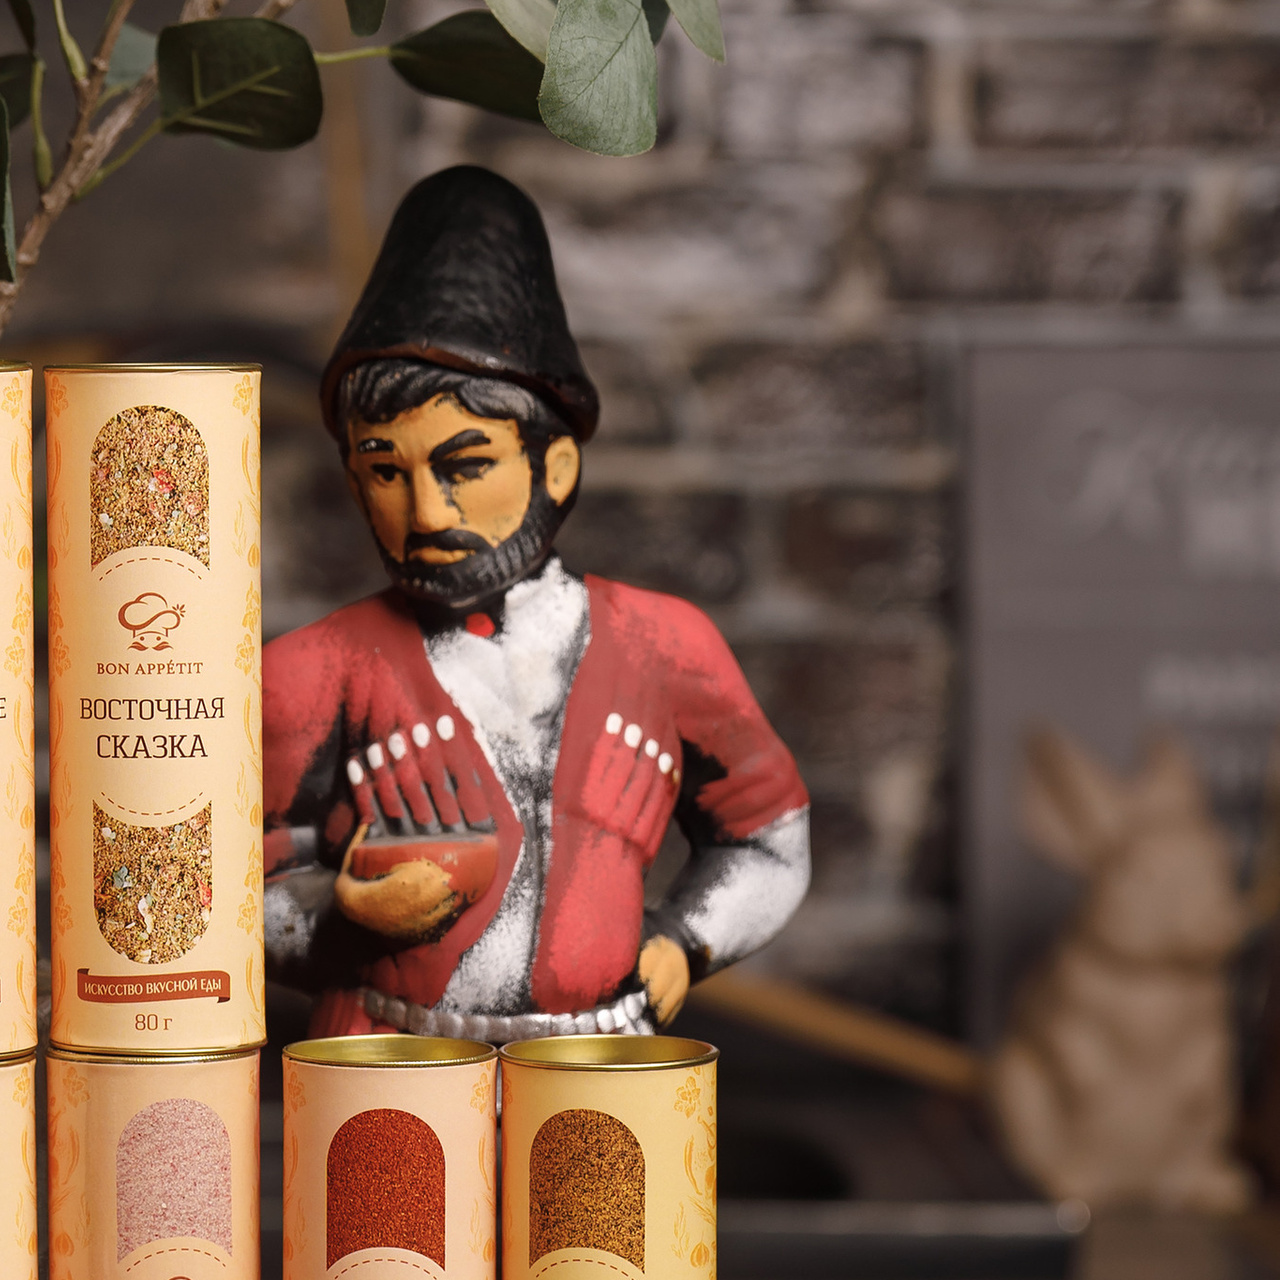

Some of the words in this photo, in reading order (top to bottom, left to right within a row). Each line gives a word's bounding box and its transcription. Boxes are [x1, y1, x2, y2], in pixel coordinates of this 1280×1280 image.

[96, 662, 130, 675] BON
[135, 659, 204, 675] APPÉTIT
[79, 696, 226, 721] ВОСТОЧНАЯ
[96, 734, 209, 759] СКАЗКА
[84, 982, 144, 996] ИСКУССТВО
[146, 976, 198, 995] ВКУСНОЙ
[200, 978, 222, 993] ЕДЫ
[134, 1013, 159, 1031] 80
[163, 1017, 173, 1031] г
